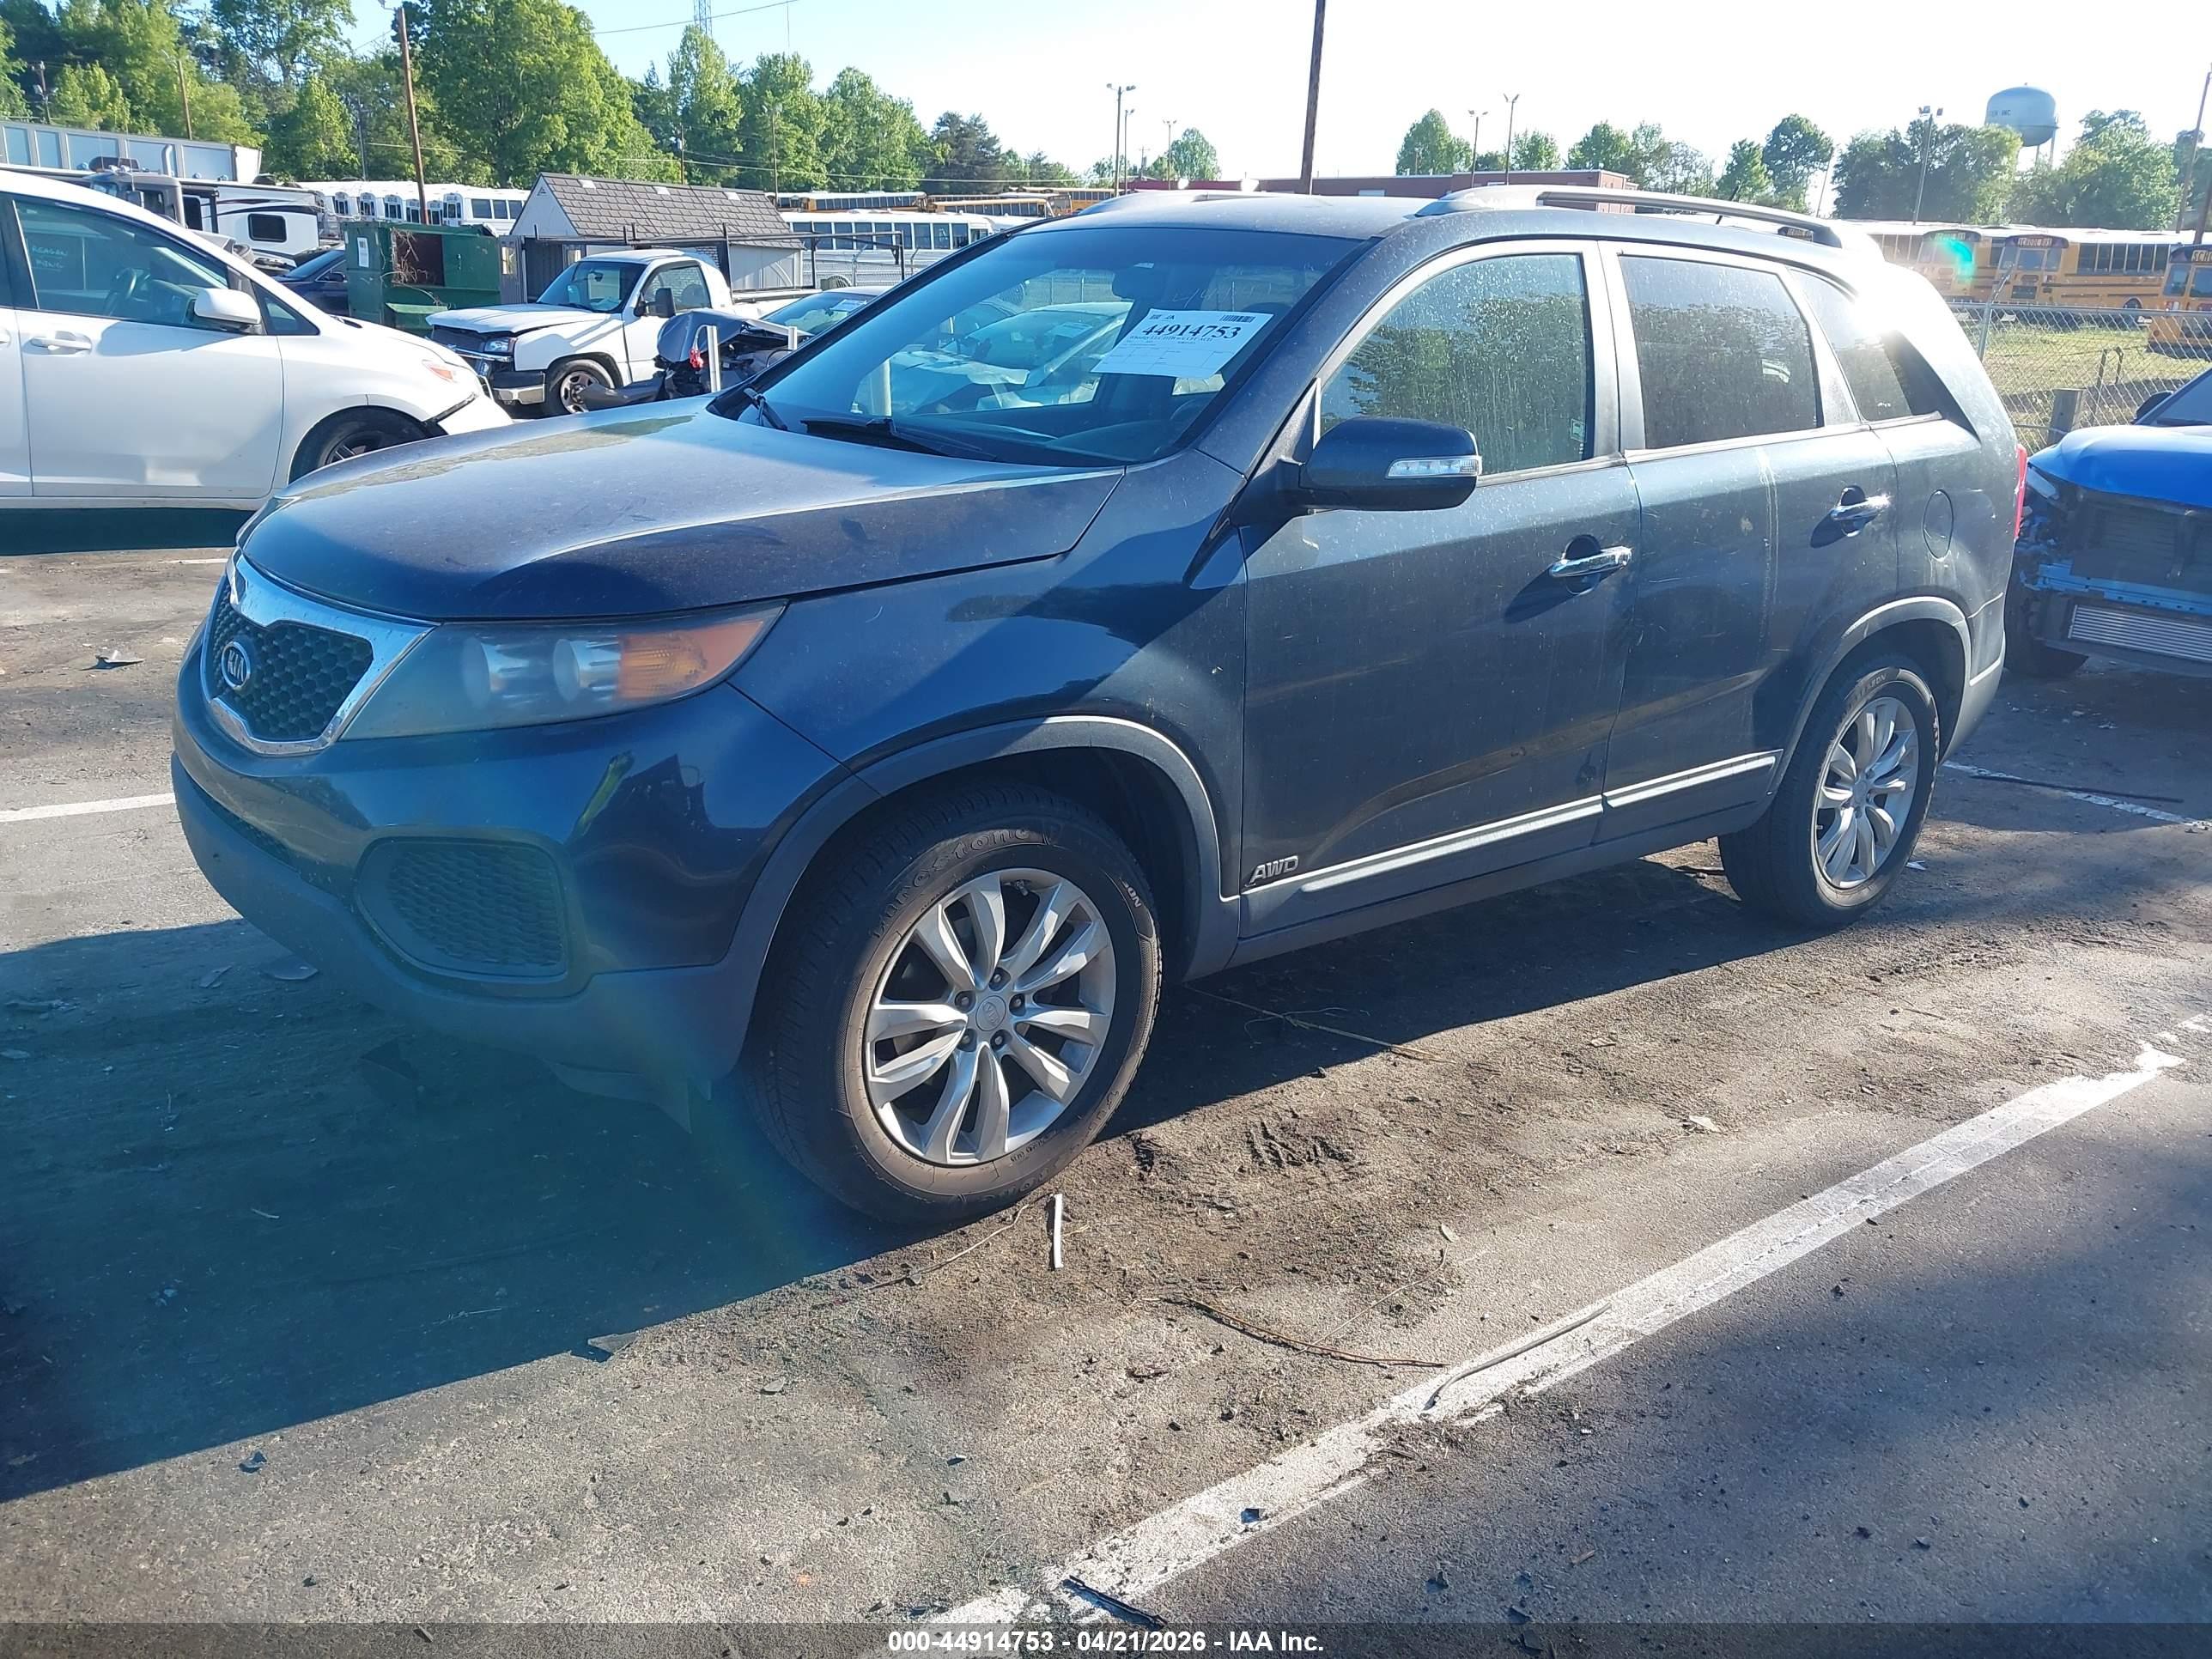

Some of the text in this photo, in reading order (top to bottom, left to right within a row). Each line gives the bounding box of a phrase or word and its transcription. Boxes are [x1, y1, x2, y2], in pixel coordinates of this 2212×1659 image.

[1142, 323, 1242, 339] 44914753
[228, 649, 245, 683] KIA
[1246, 855, 1299, 885] AWD
